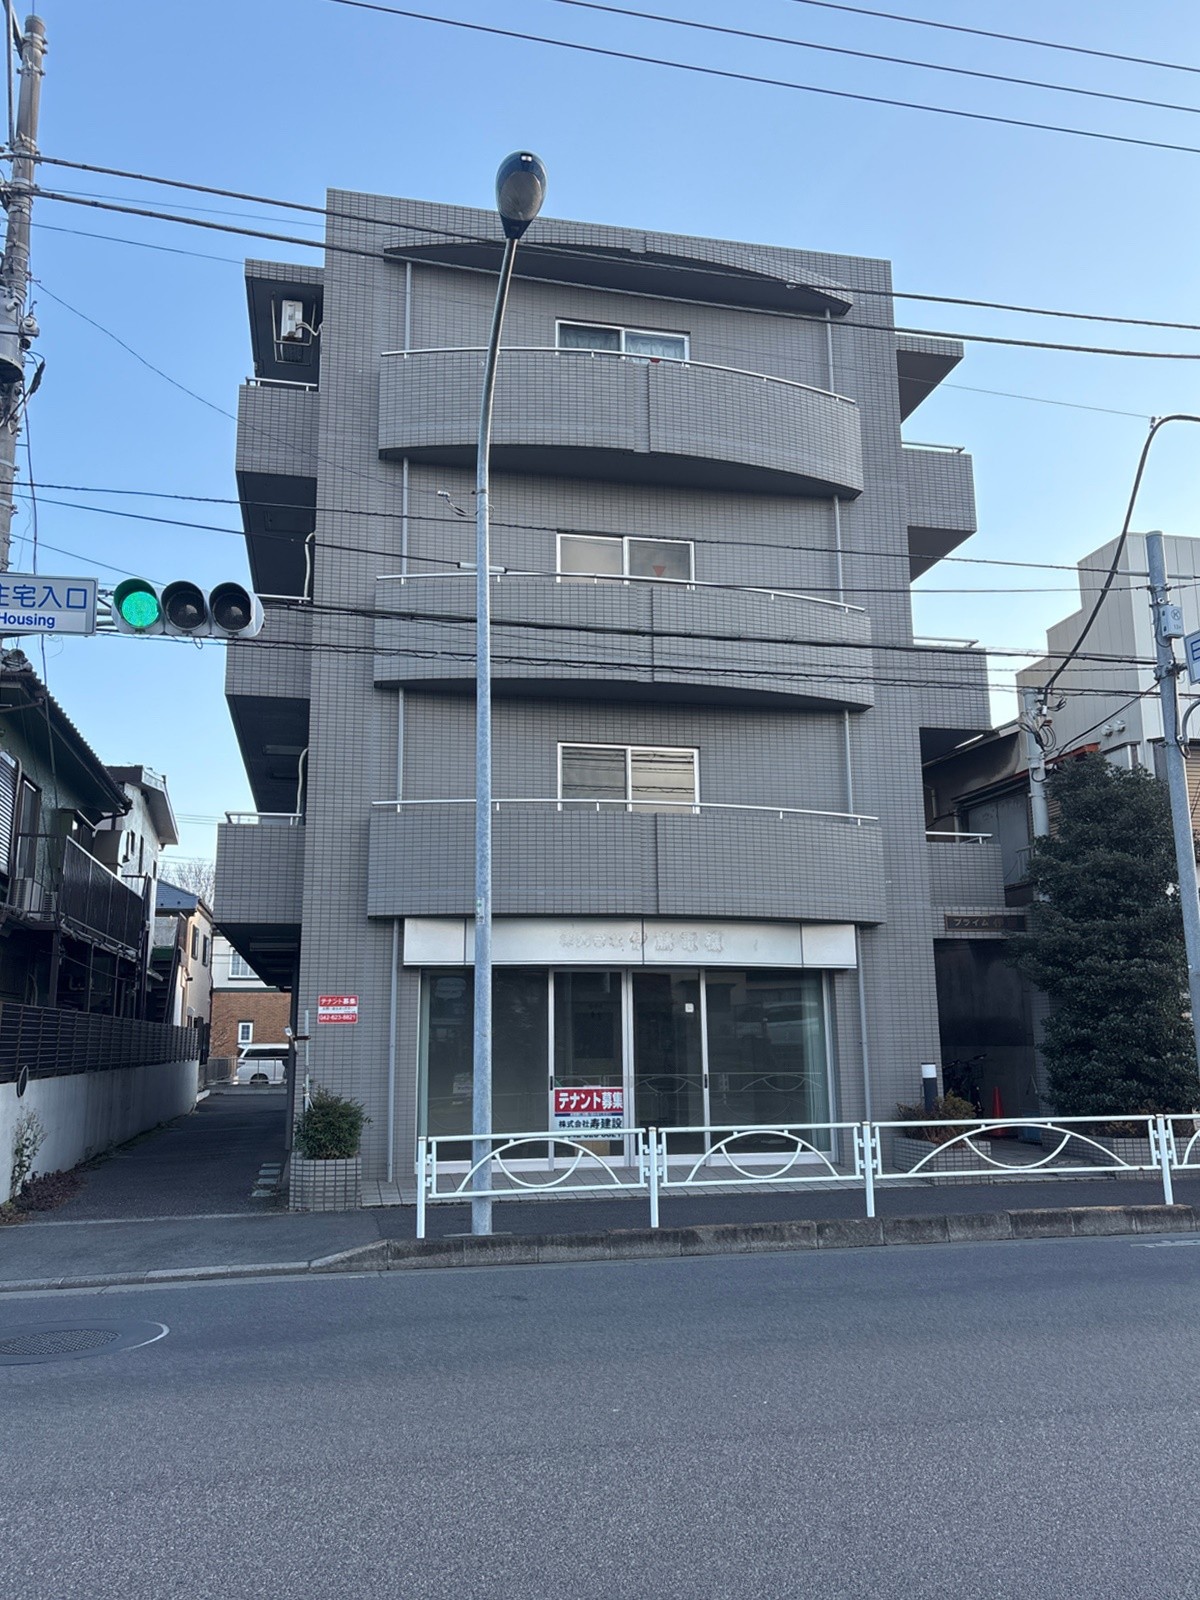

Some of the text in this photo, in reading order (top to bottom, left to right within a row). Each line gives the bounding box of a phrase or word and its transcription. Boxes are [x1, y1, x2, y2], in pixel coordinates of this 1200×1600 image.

[320, 997, 357, 1006] テナント募集
[559, 1092, 623, 1109] テナント募集
[559, 1118, 622, 1129] 株式会社寿建設
